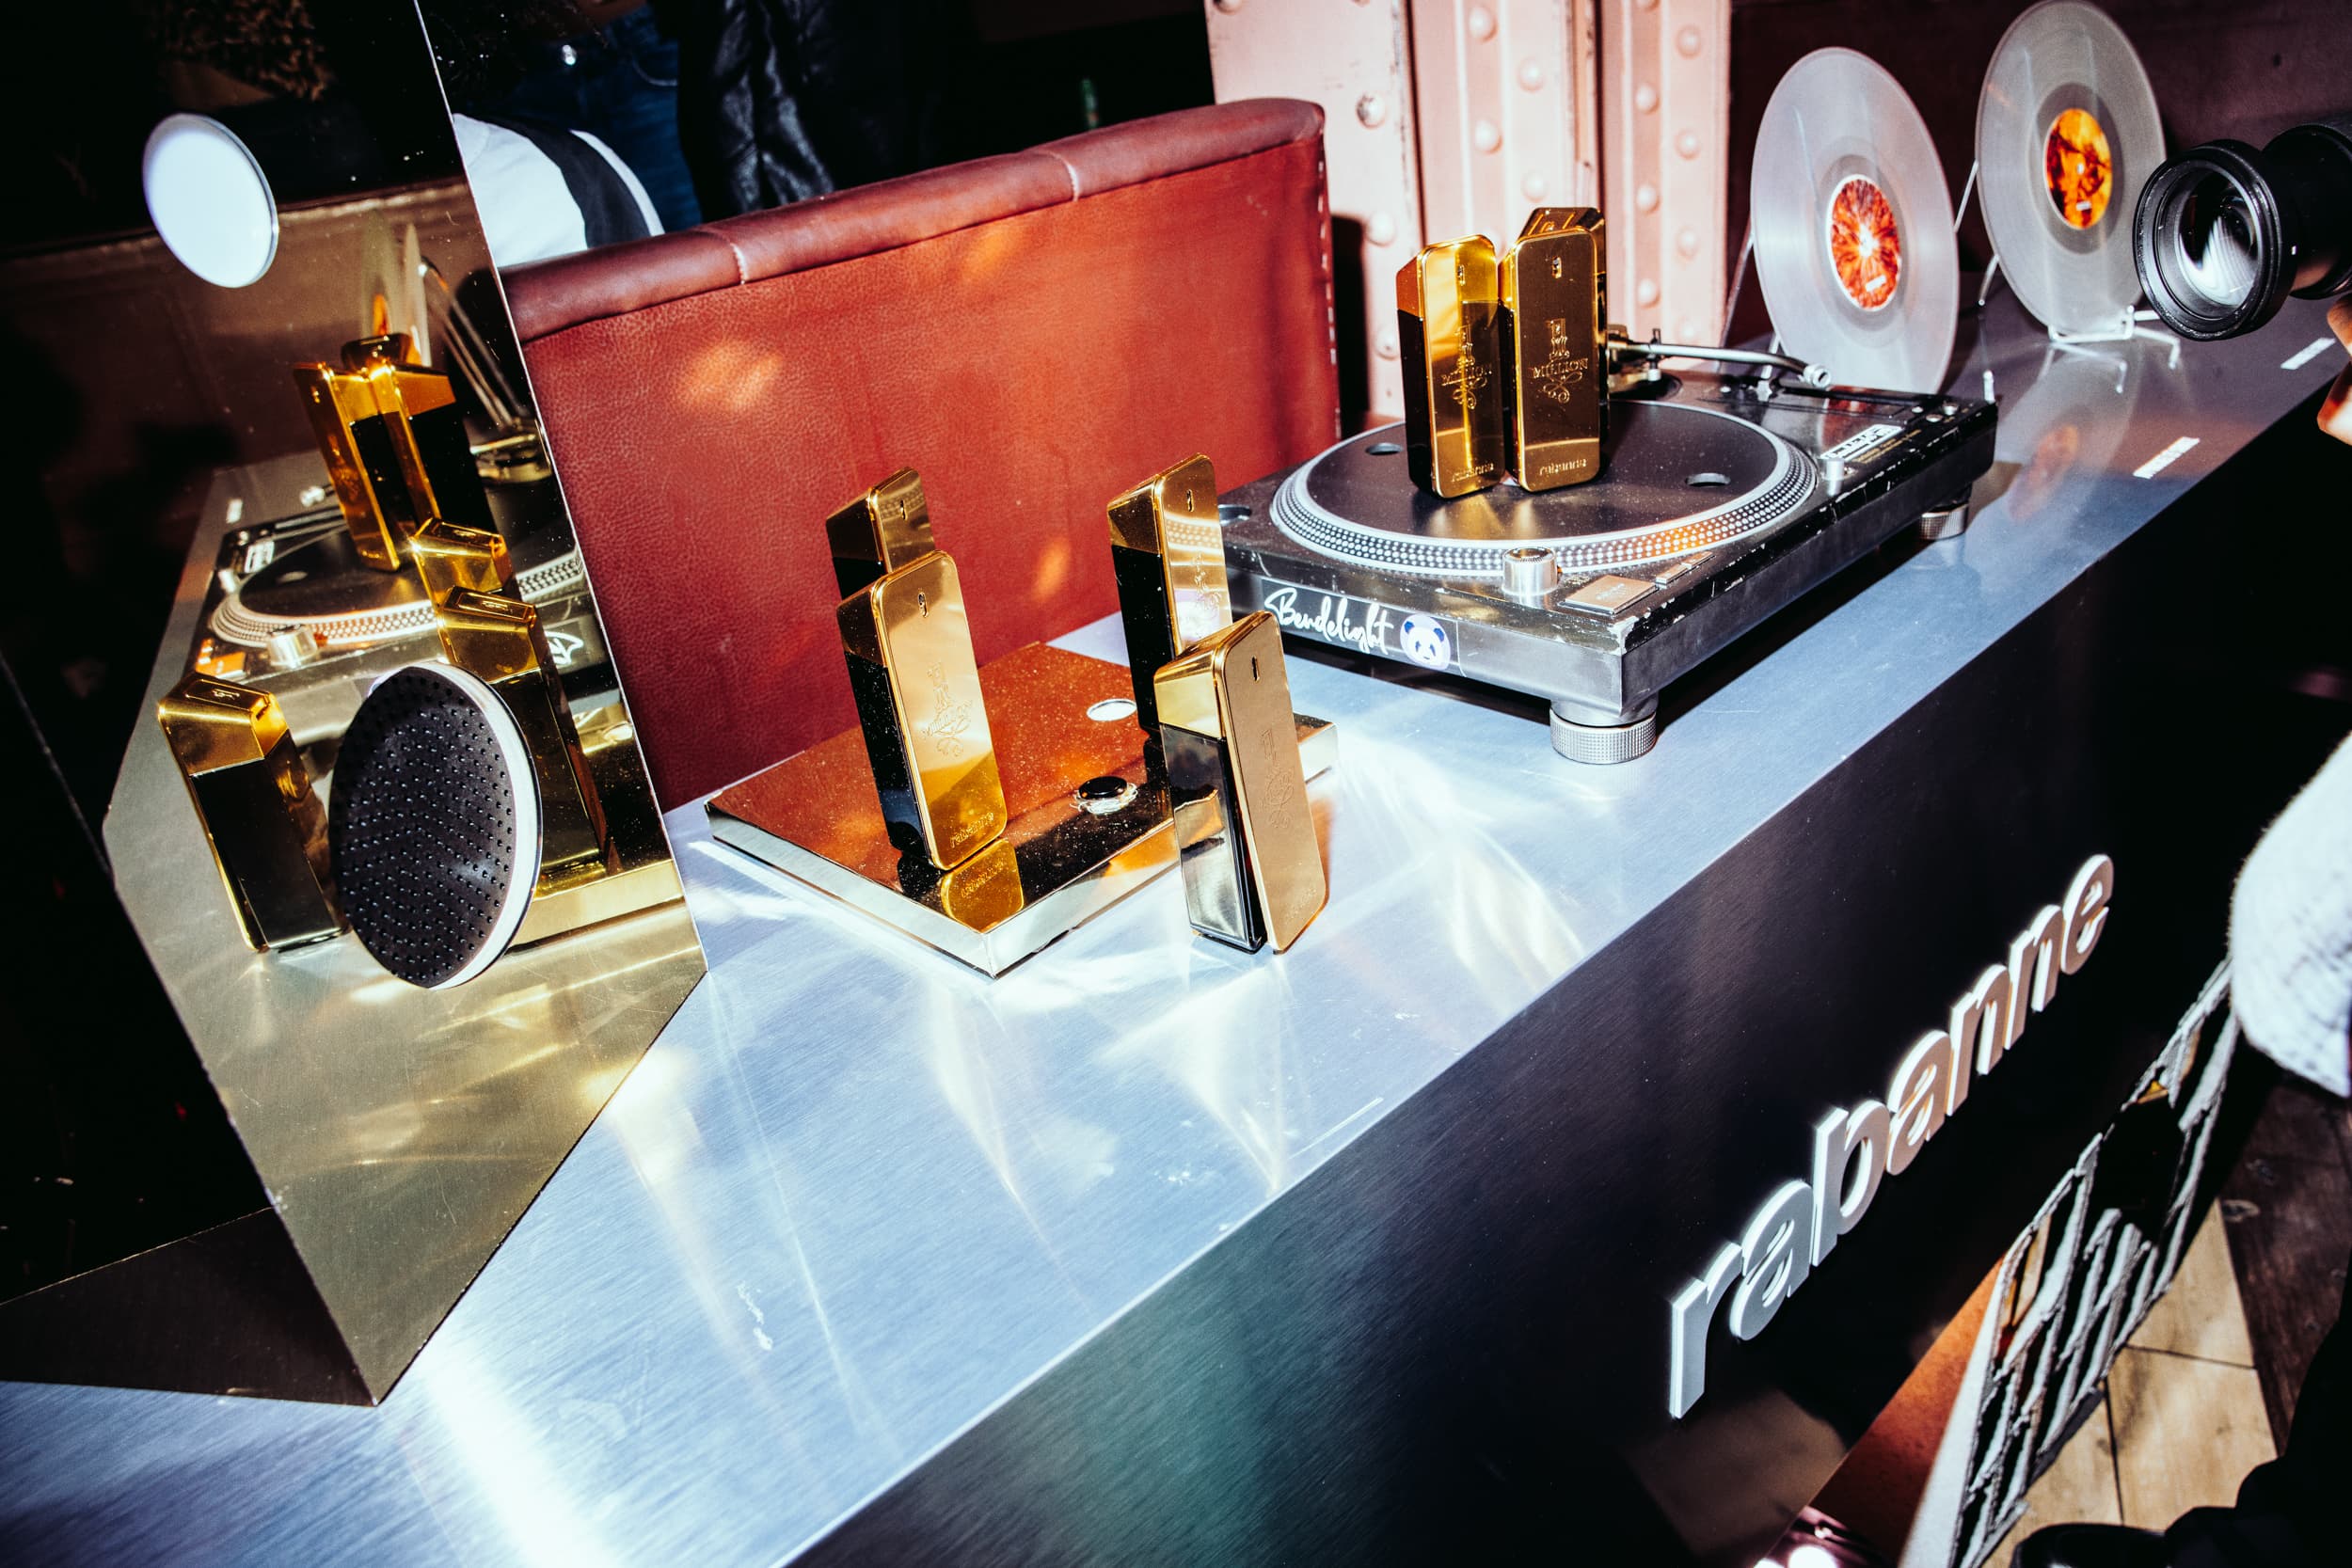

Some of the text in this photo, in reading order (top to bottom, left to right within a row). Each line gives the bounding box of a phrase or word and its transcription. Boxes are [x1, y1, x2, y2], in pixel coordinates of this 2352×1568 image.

[1532, 357, 1589, 379] MILLION
[1263, 587, 1394, 656] Bendelight
[1669, 853, 2115, 1420] rabanne
